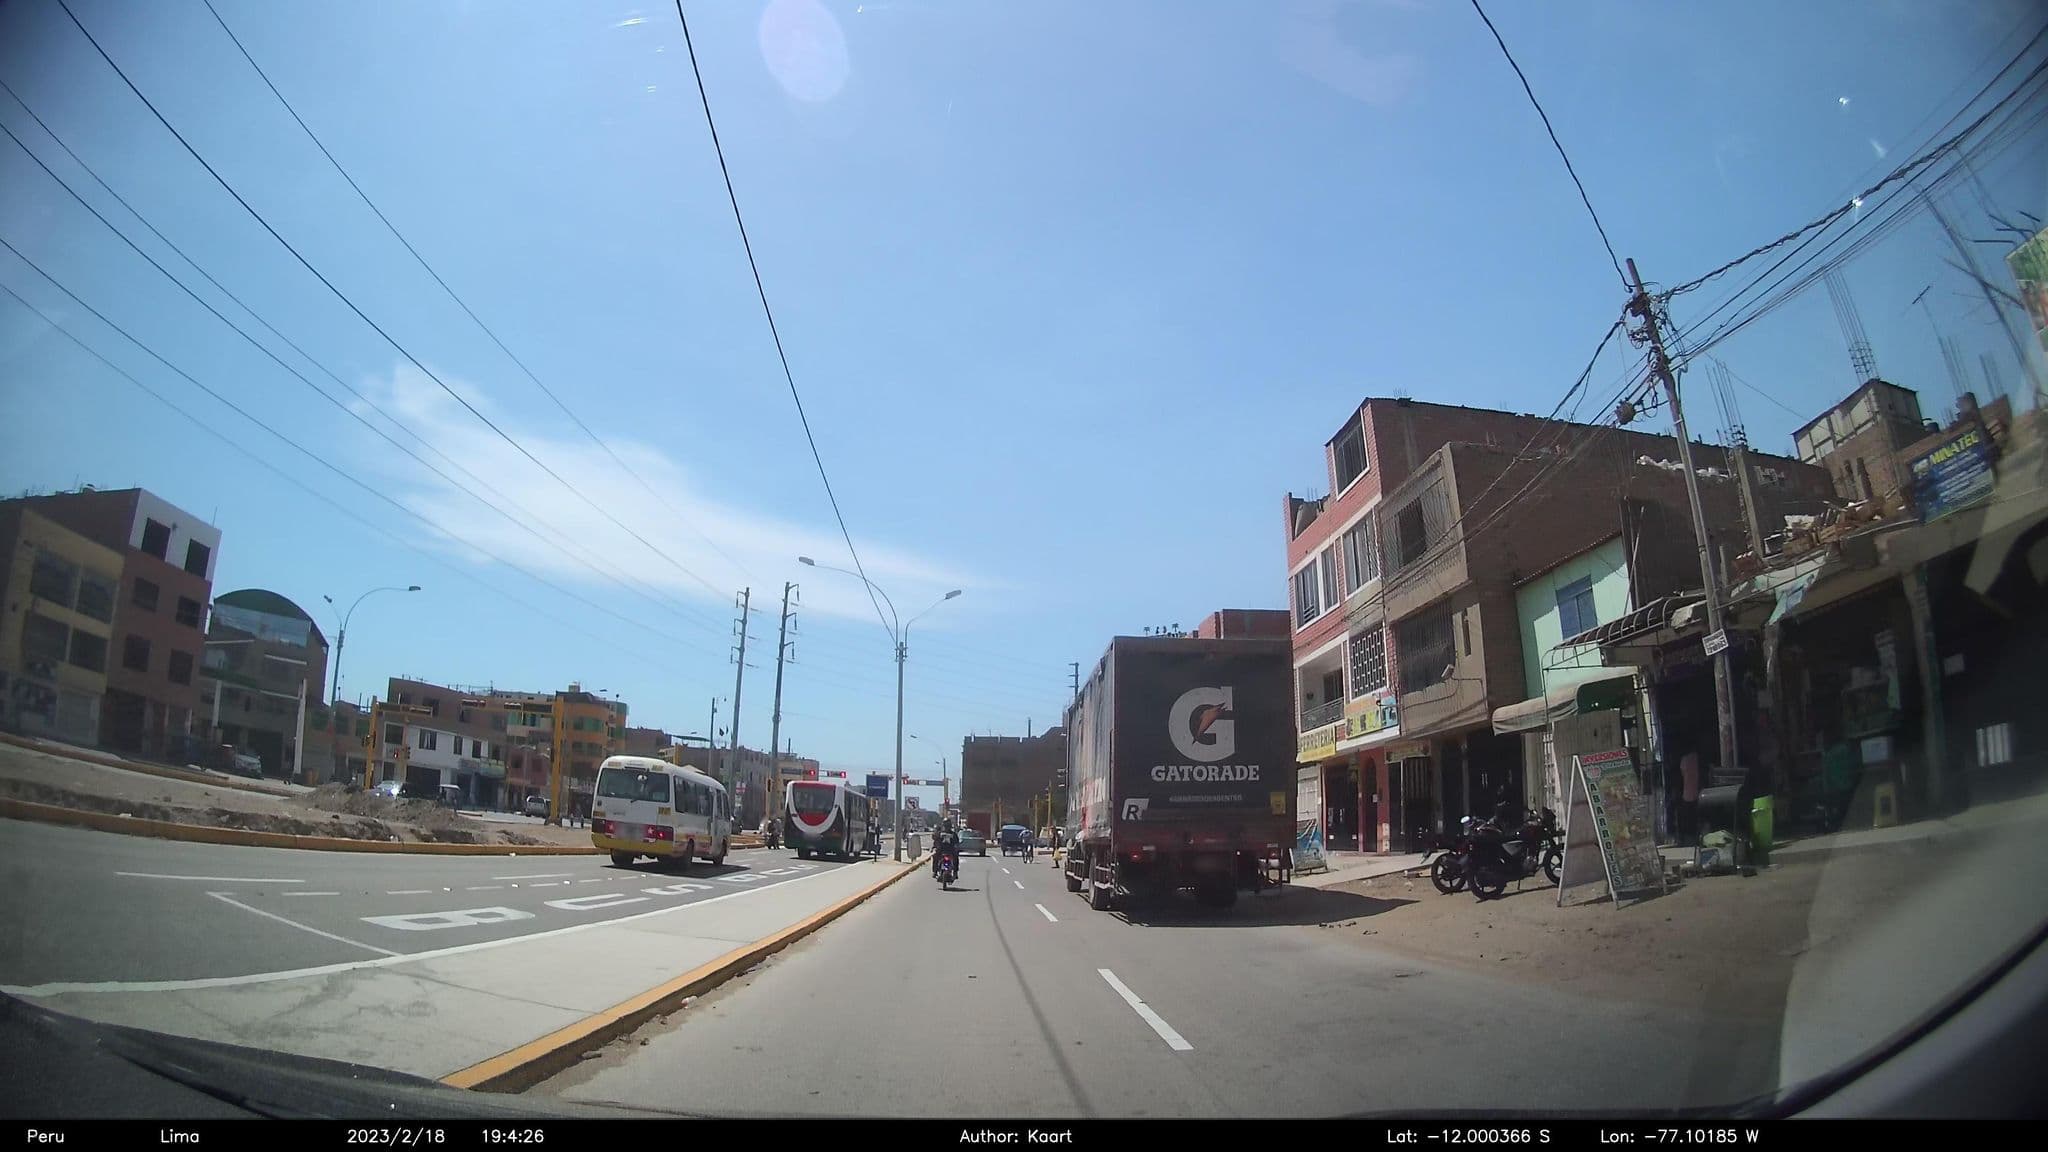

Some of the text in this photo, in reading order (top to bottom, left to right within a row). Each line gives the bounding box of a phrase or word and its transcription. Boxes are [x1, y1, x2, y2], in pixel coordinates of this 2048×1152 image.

[1168, 686, 1235, 762] G
[1150, 765, 1260, 782] GATORADE
[1589, 782, 1621, 887] ABARROTES
[360, 883, 714, 931] BUS
